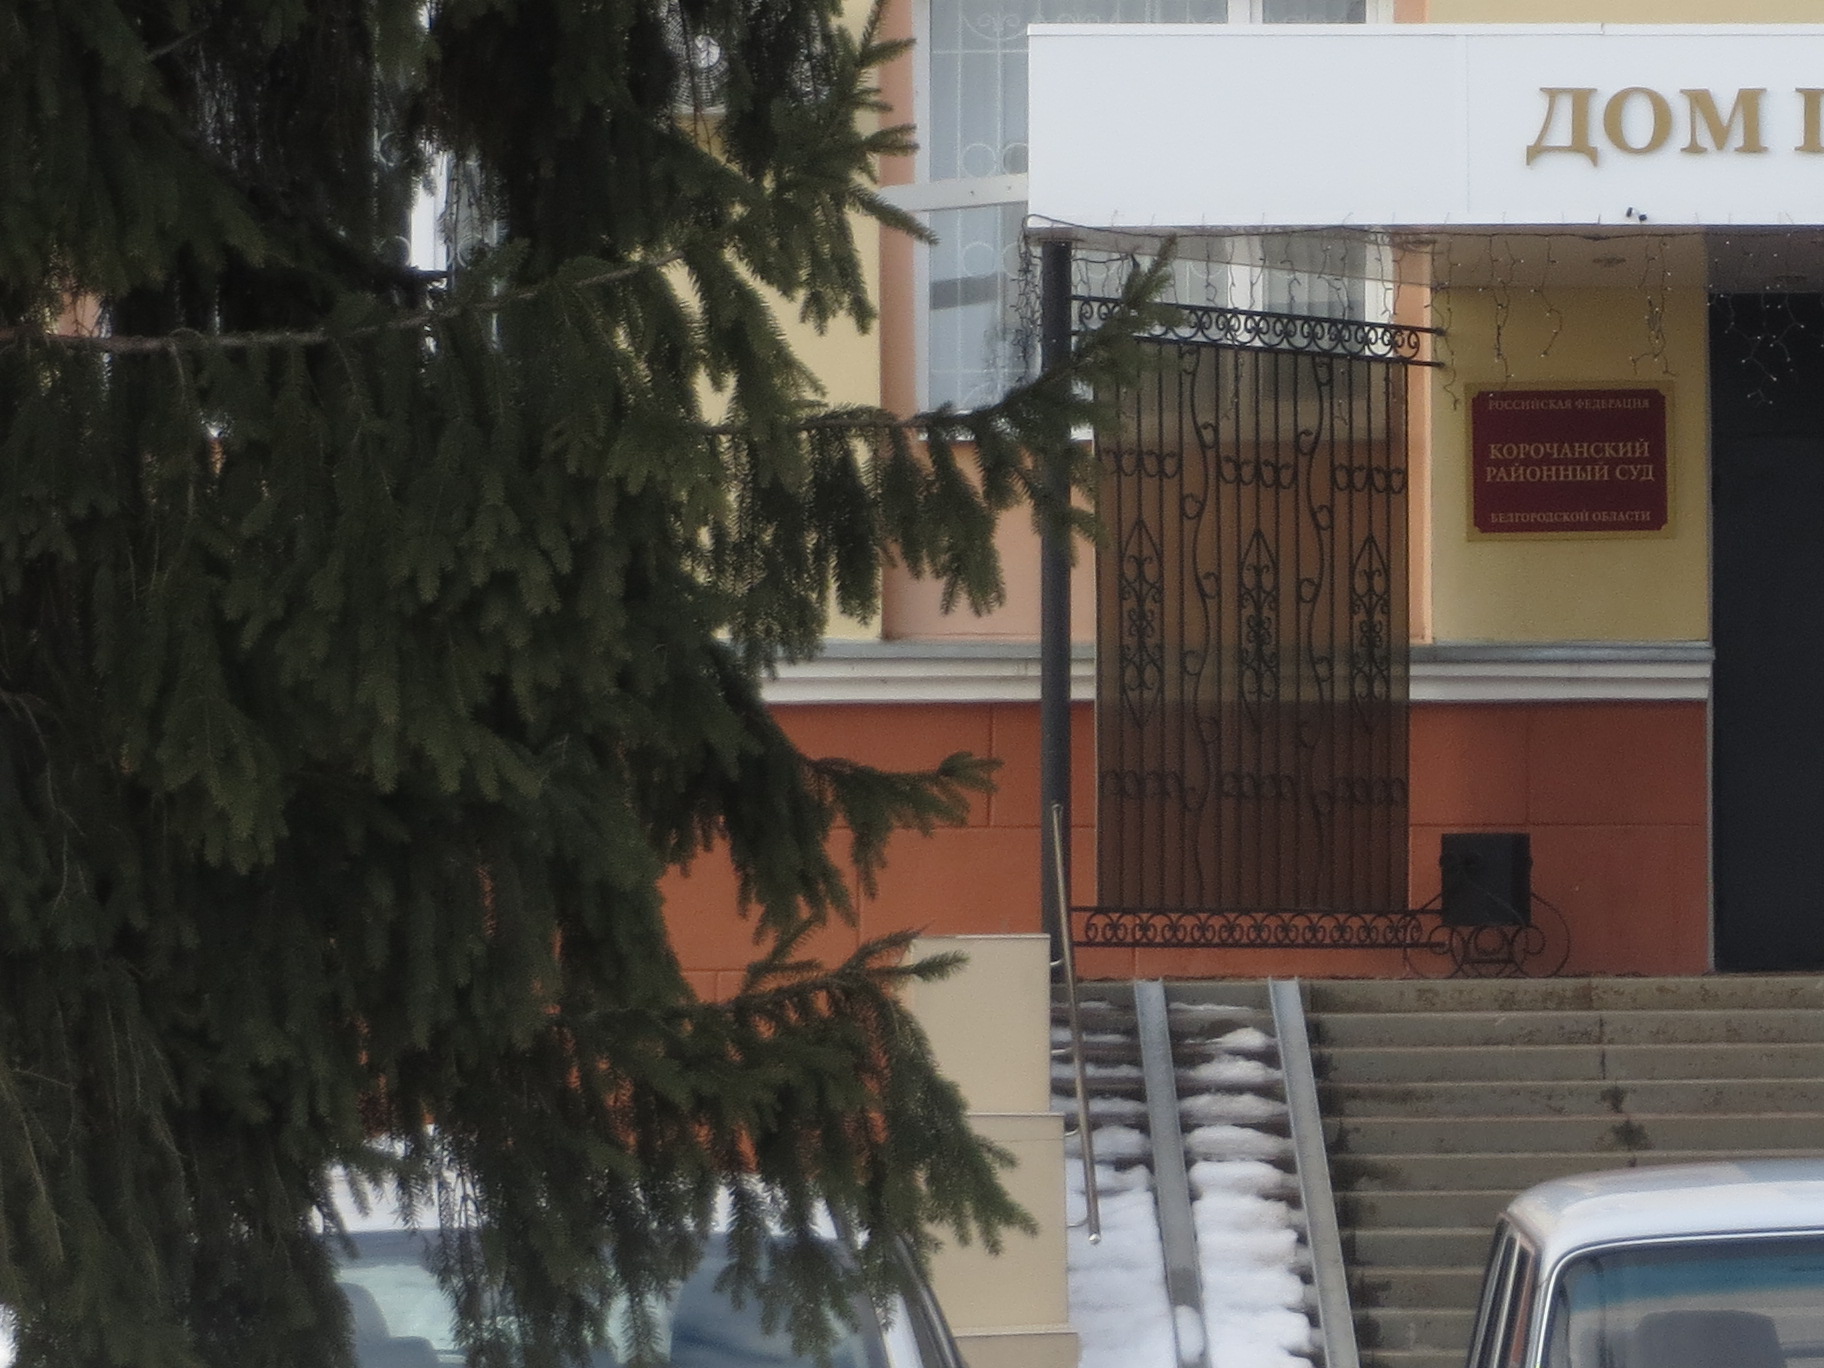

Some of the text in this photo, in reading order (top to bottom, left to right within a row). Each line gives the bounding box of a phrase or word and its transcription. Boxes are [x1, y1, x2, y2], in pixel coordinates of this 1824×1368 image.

[1526, 86, 1769, 167] ДОМ
[1488, 397, 1650, 411] РОССИЙСКАЯ ФЕДЕРАЦИЯ
[1487, 438, 1650, 460] КОРОЧАНСКИЙ
[1485, 462, 1656, 483] РАЙОННЫЙ СУД
[1490, 509, 1652, 524] БЕЛГОРОДСКОЙ ОБЛАСТИ
